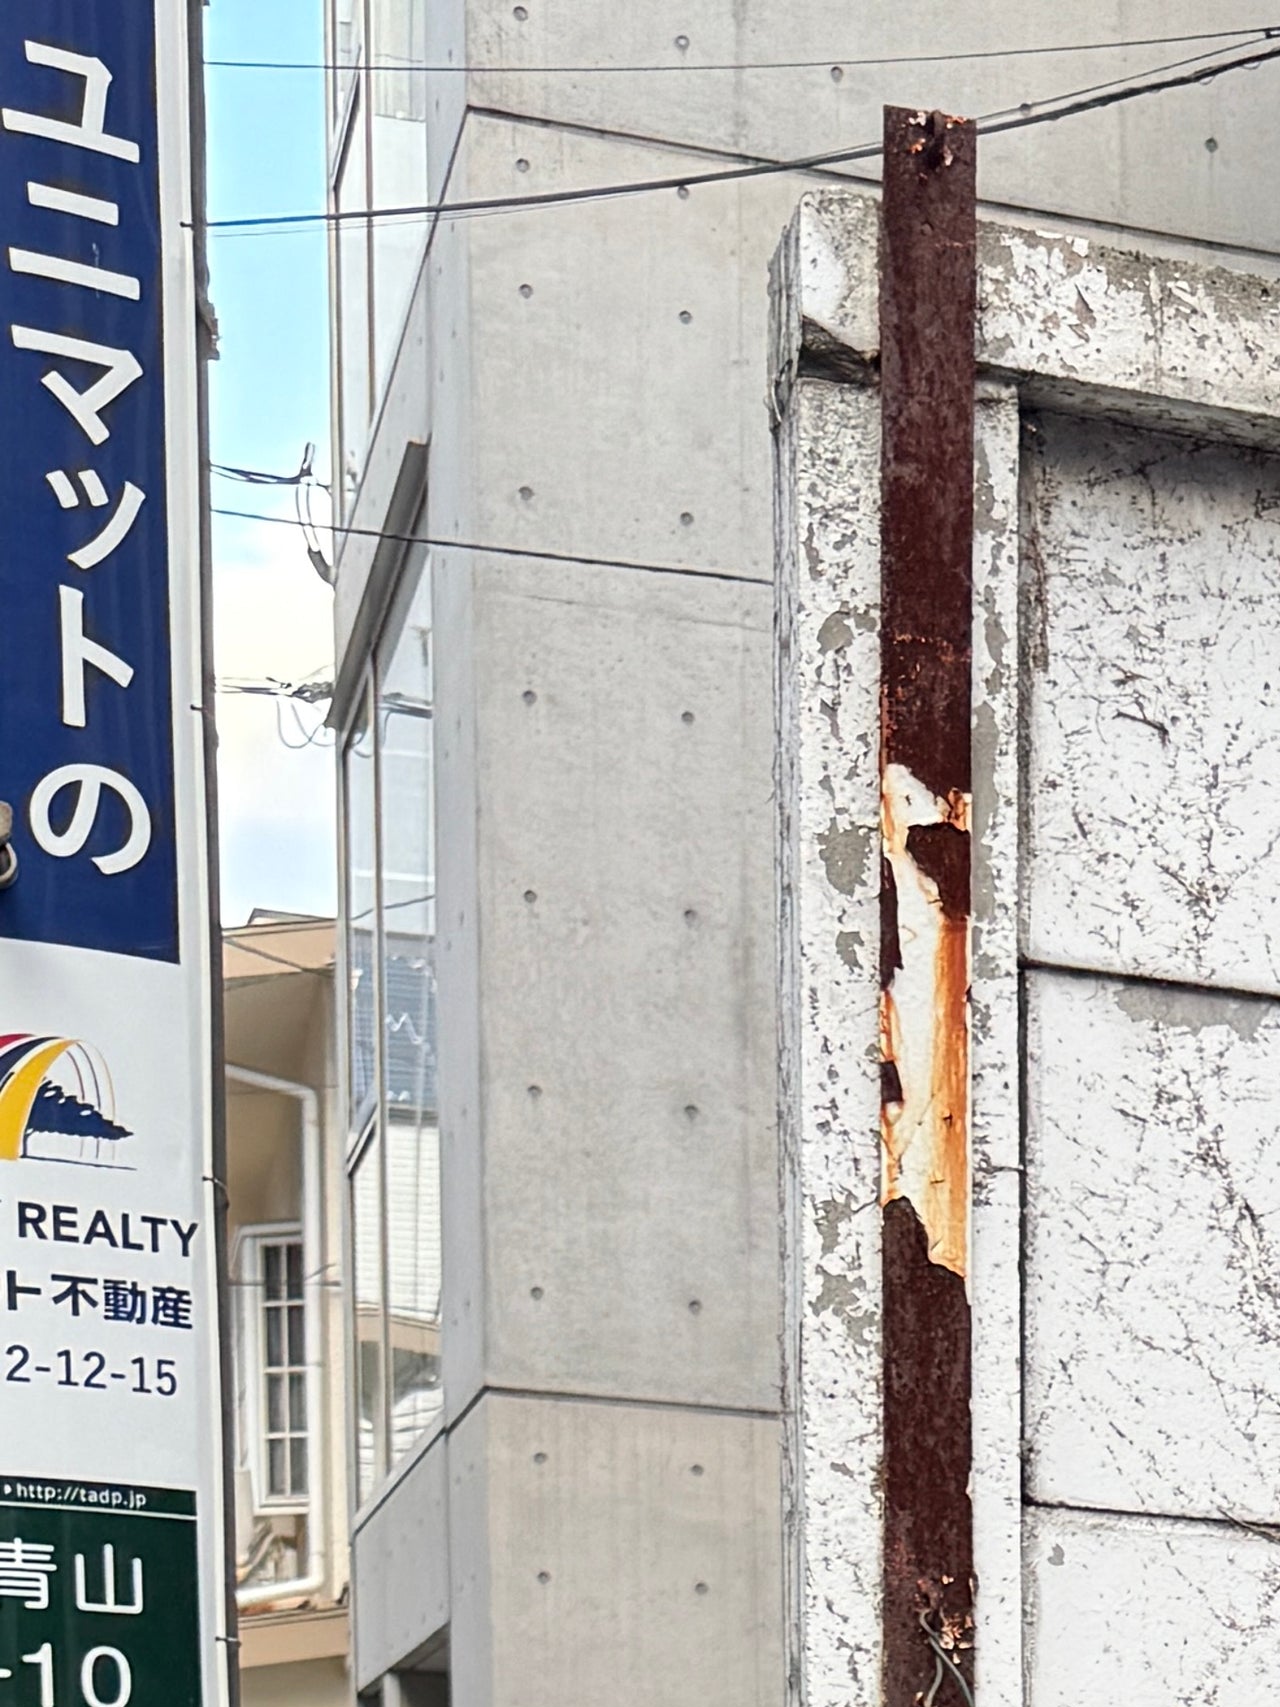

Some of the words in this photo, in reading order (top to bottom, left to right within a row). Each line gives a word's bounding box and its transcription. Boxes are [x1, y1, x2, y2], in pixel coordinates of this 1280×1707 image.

[2, 39, 152, 875] ユニマットの
[17, 1201, 199, 1257] REALTY
[6, 1269, 193, 1330] ト不動産
[6, 1344, 178, 1396] 2-12-15
[16, 1482, 147, 1509] http://tadp.jp
[0, 1536, 144, 1615] 青山
